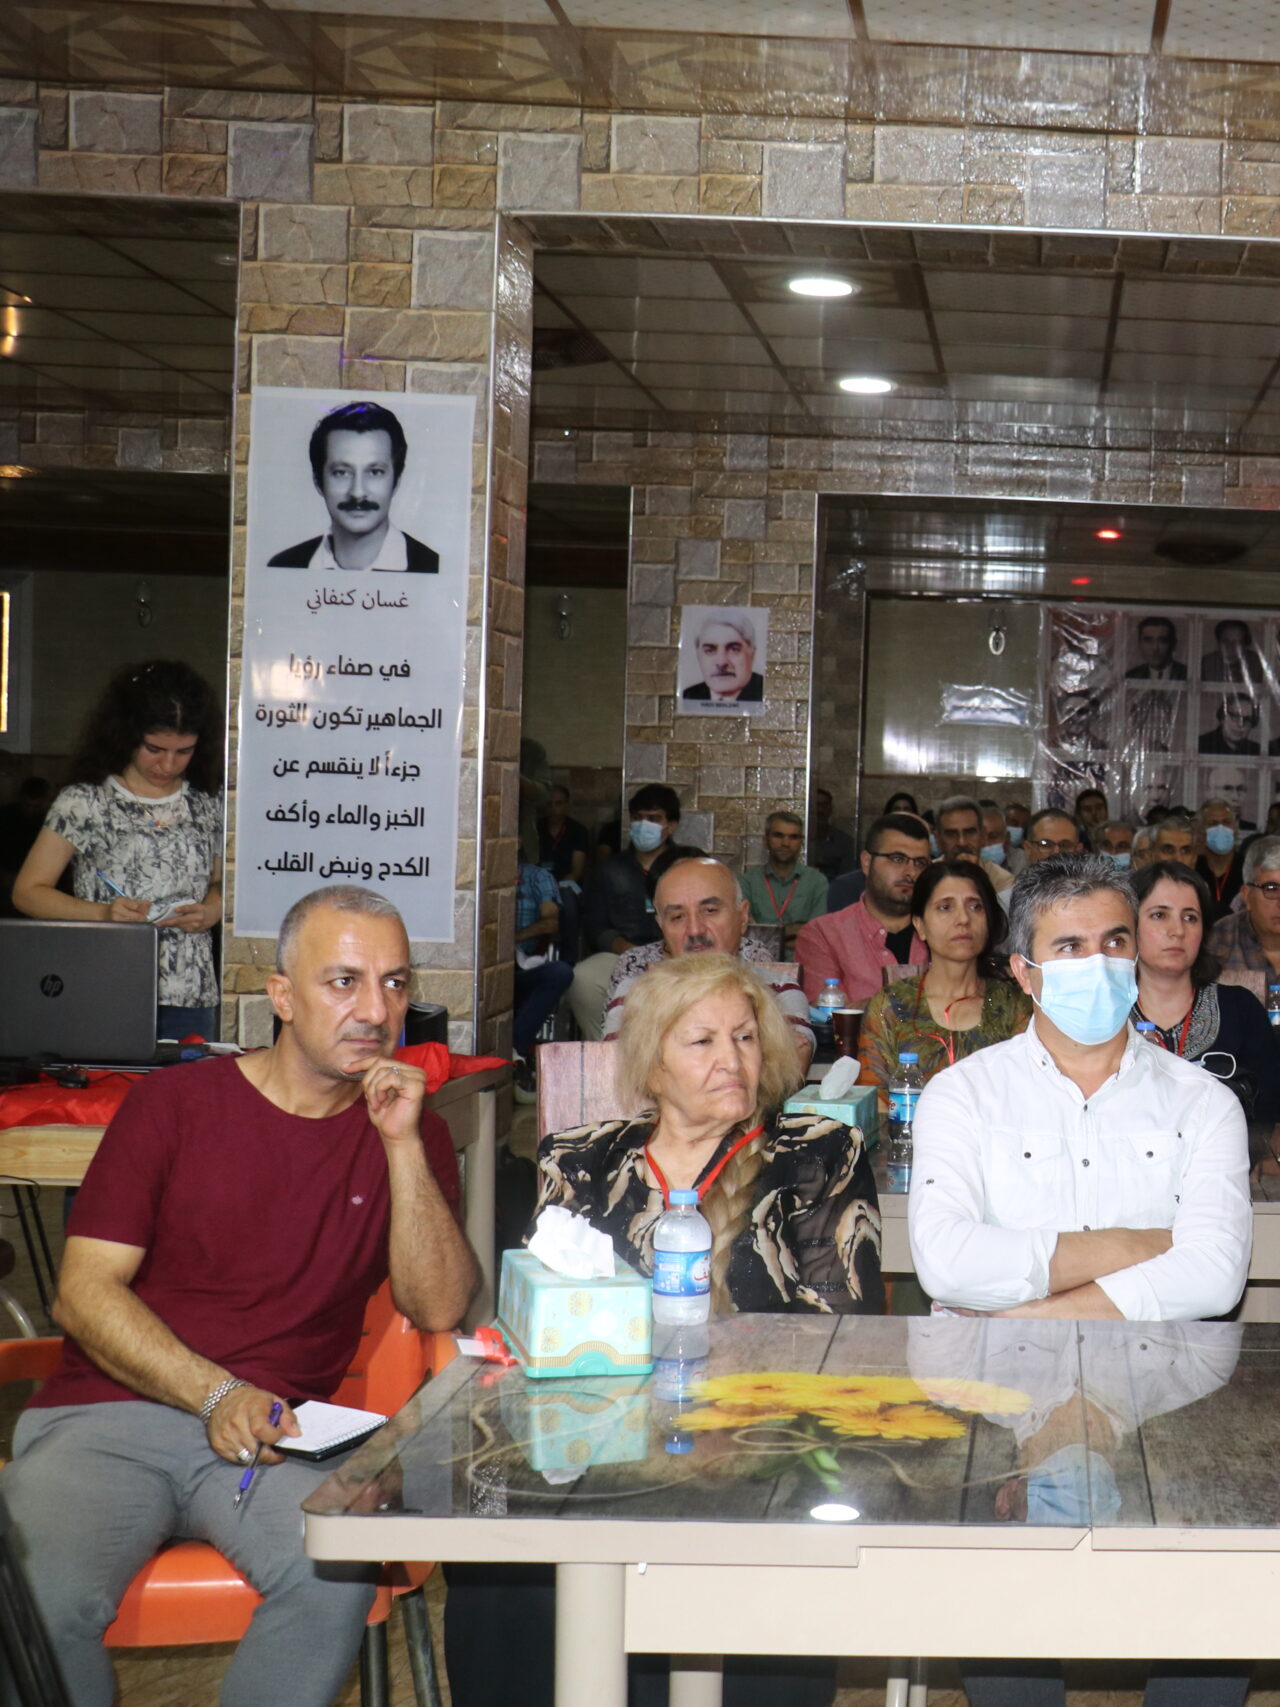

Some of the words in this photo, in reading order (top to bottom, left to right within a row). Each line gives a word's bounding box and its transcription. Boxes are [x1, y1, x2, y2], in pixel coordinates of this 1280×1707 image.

[307, 588, 357, 614] كنفاني
[362, 590, 409, 610] غسان
[327, 655, 373, 676] صفاء
[379, 659, 411, 681] في
[256, 703, 307, 728] الثورة
[313, 706, 363, 730] تكون
[366, 707, 442, 732] الجماهير
[273, 758, 300, 777] عن
[306, 757, 363, 779] ينقسم
[369, 756, 380, 775] لا
[266, 800, 320, 828] وأكف
[326, 804, 380, 831] والماء
[385, 807, 425, 831] الخبز
[319, 856, 372, 880] ونبض
[379, 857, 430, 880] الكدح
[43, 974, 62, 997] hp
